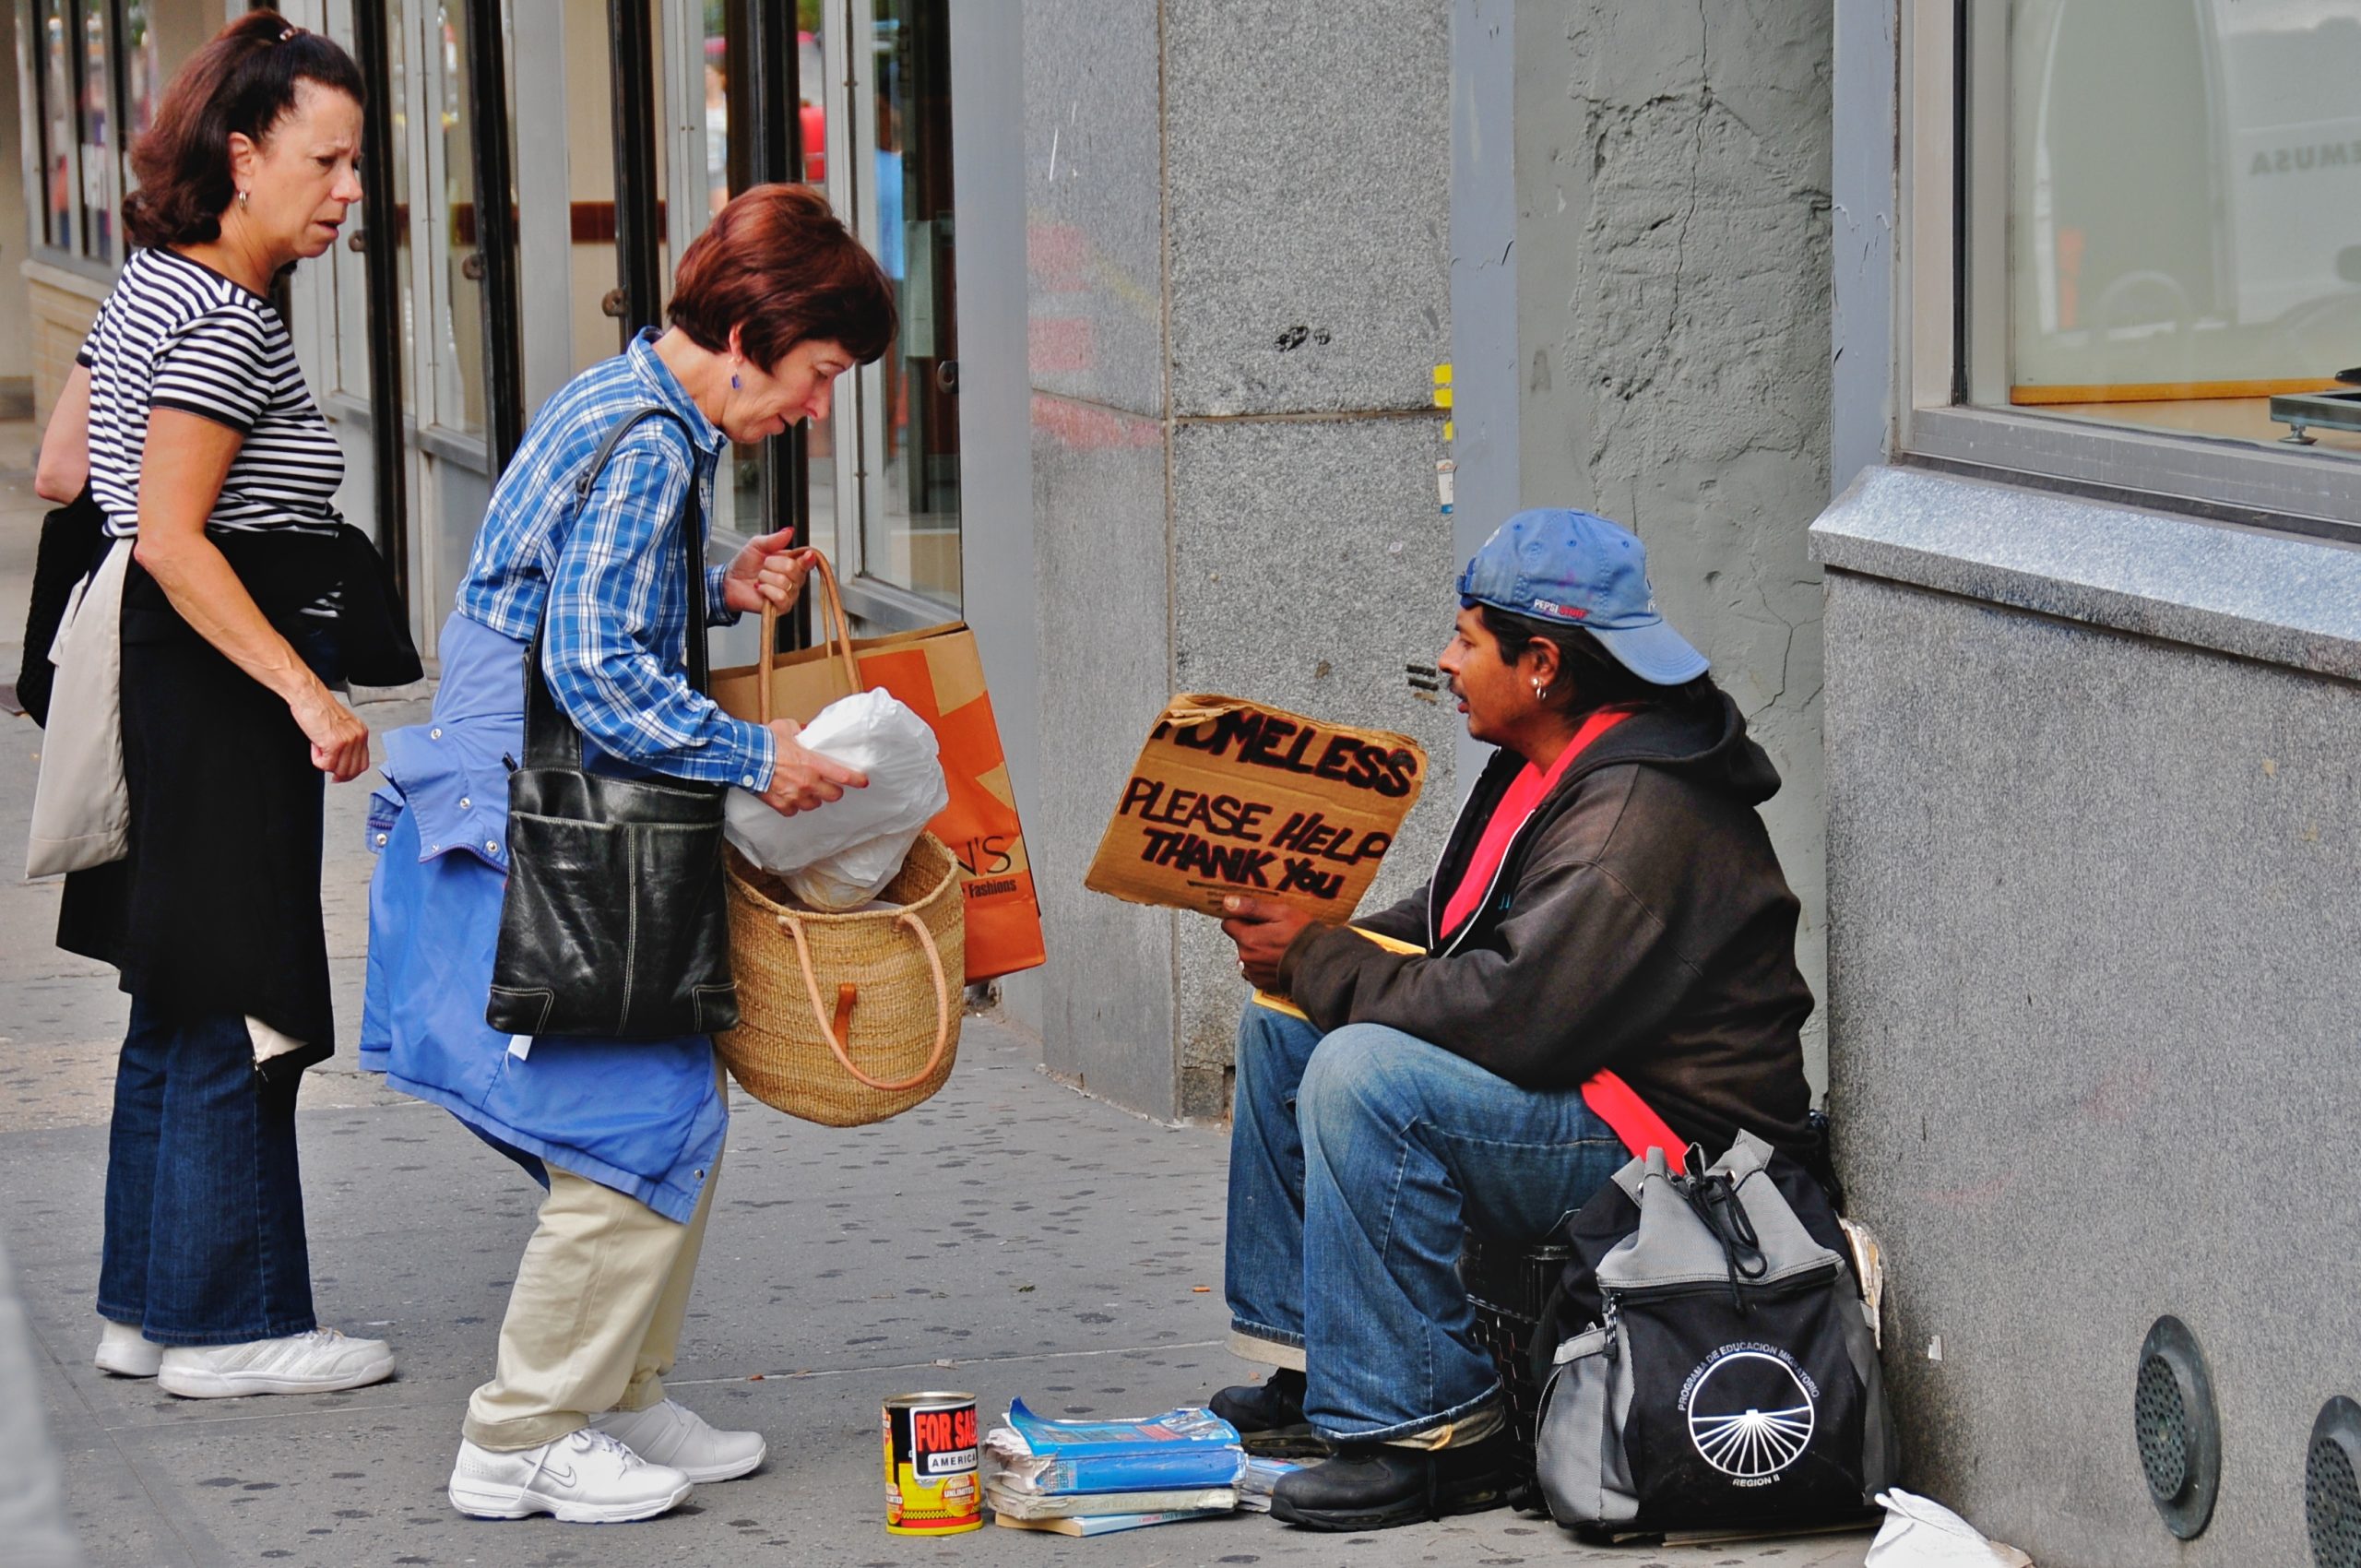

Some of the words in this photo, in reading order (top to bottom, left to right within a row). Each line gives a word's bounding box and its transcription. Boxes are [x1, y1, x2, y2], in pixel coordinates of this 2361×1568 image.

[1534, 599, 1559, 614] PEPSI
[1120, 777, 1273, 842] PLEASE
[1269, 812, 1392, 865] HELP
[1142, 826, 1278, 888] THANK
[968, 878, 1017, 898] Fashions
[1678, 1362, 1708, 1411] PROGRAMA
[1706, 1349, 1720, 1364] DE
[1719, 1342, 1778, 1355] EDUCACION
[1778, 1348, 1821, 1398] MIGRATORIO
[915, 1413, 952, 1452] FOR
[1732, 1476, 1772, 1487] REGION
